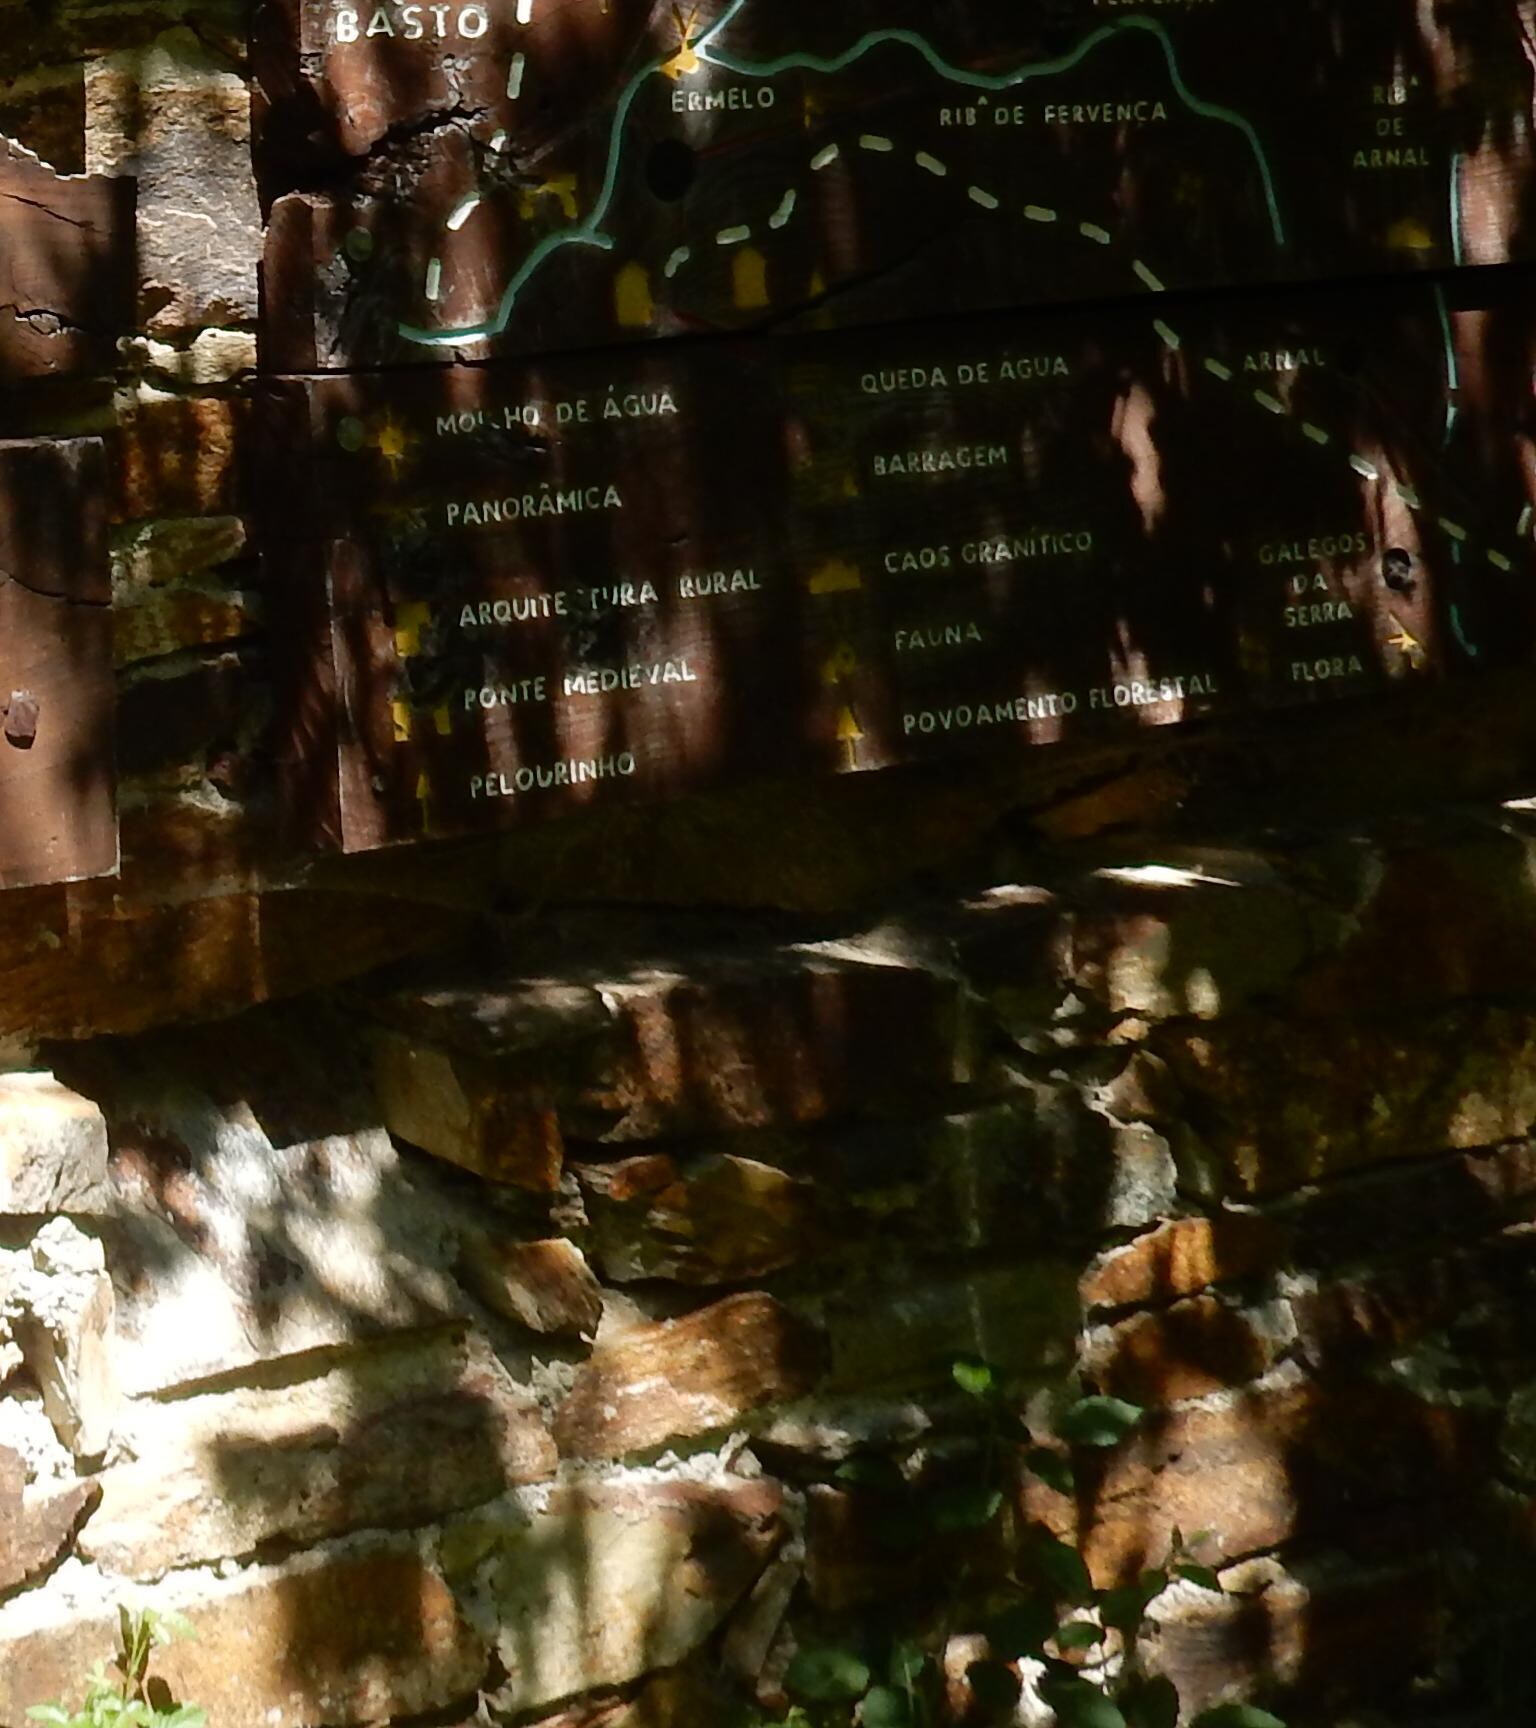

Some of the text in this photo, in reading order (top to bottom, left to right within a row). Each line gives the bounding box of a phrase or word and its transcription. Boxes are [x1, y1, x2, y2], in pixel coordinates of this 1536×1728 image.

[335, 6, 489, 43] BASTO
[671, 87, 776, 113] ERMELO
[994, 106, 1024, 124] DE
[1044, 100, 1167, 128] FERVENÇA
[1352, 146, 1430, 169] ARNAL
[860, 366, 948, 394] QUEDA
[956, 362, 990, 385] DE
[555, 400, 589, 424] DE
[603, 384, 679, 420] ÁGUA
[873, 445, 1008, 476] BARRAGEM
[446, 482, 623, 527] PANORÂMICA
[884, 526, 1093, 574] CAOS GRANÍTICO
[1259, 531, 1368, 565] GALEGOS
[679, 568, 762, 600] RURAL
[1292, 574, 1328, 595] DA
[1284, 601, 1355, 627] SERRA
[895, 622, 982, 651] FAUNA
[1291, 652, 1364, 682] FLORA
[463, 659, 698, 711] PONTE MEDIEVAL
[903, 673, 1219, 736] POVOAMENTO FLORESTAL
[469, 752, 636, 801] PELOURINHO
